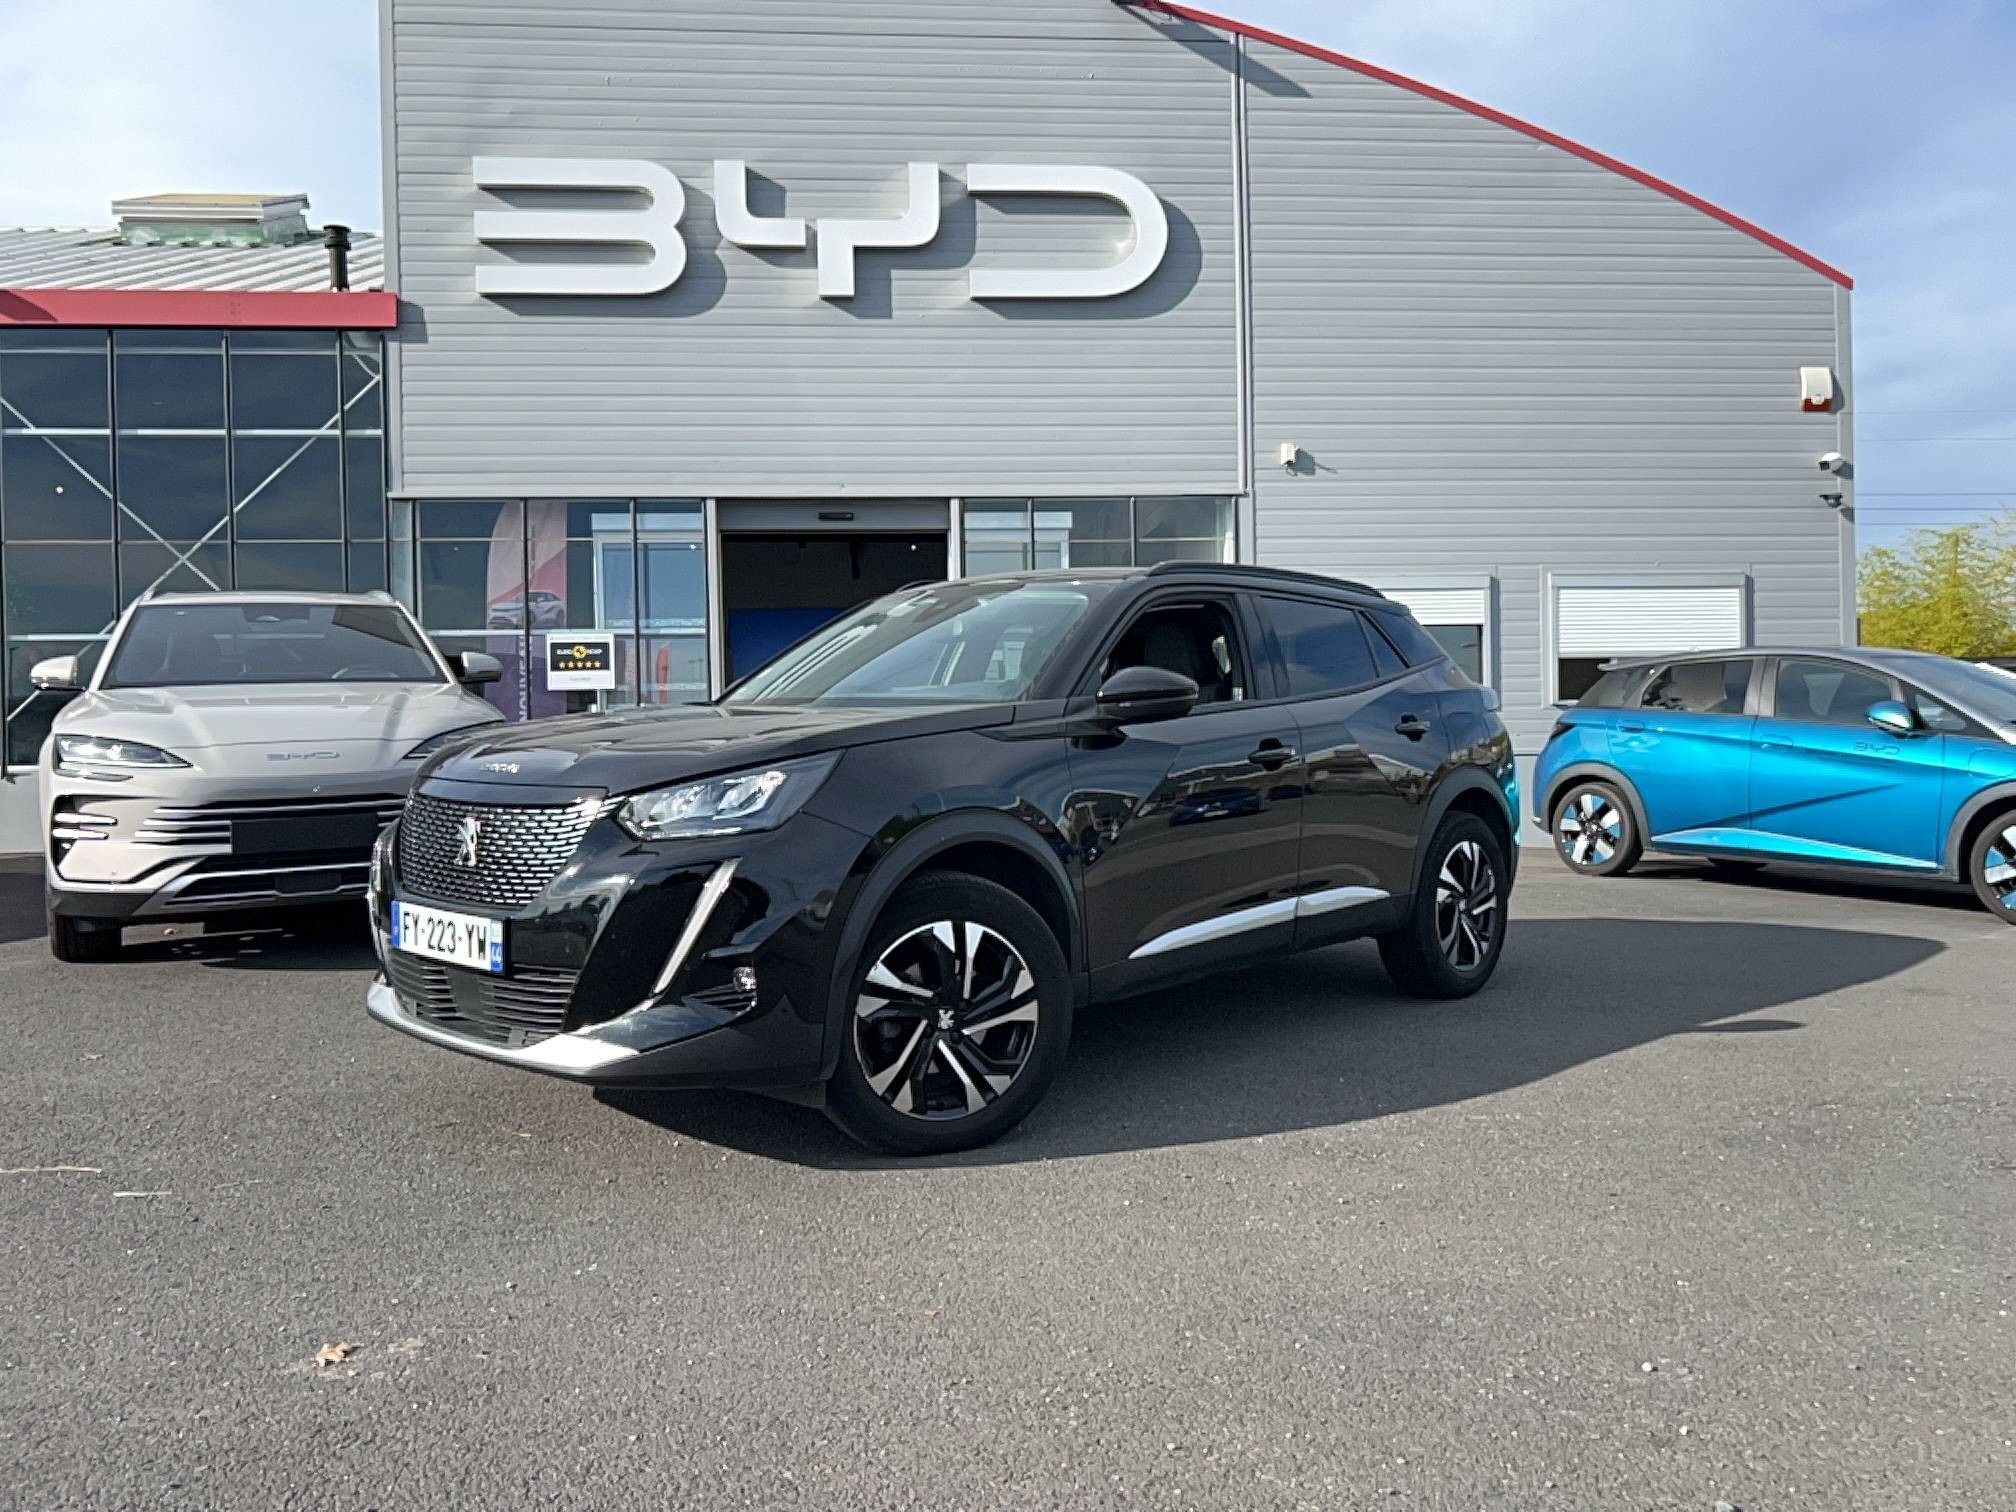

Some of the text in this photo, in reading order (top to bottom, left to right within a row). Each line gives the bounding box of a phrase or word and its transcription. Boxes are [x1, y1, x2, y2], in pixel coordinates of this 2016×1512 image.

[472, 155, 1168, 298] BYD
[266, 751, 340, 761] BYD
[1855, 741, 1900, 755] BYD
[403, 910, 487, 960] FY-223-YW
